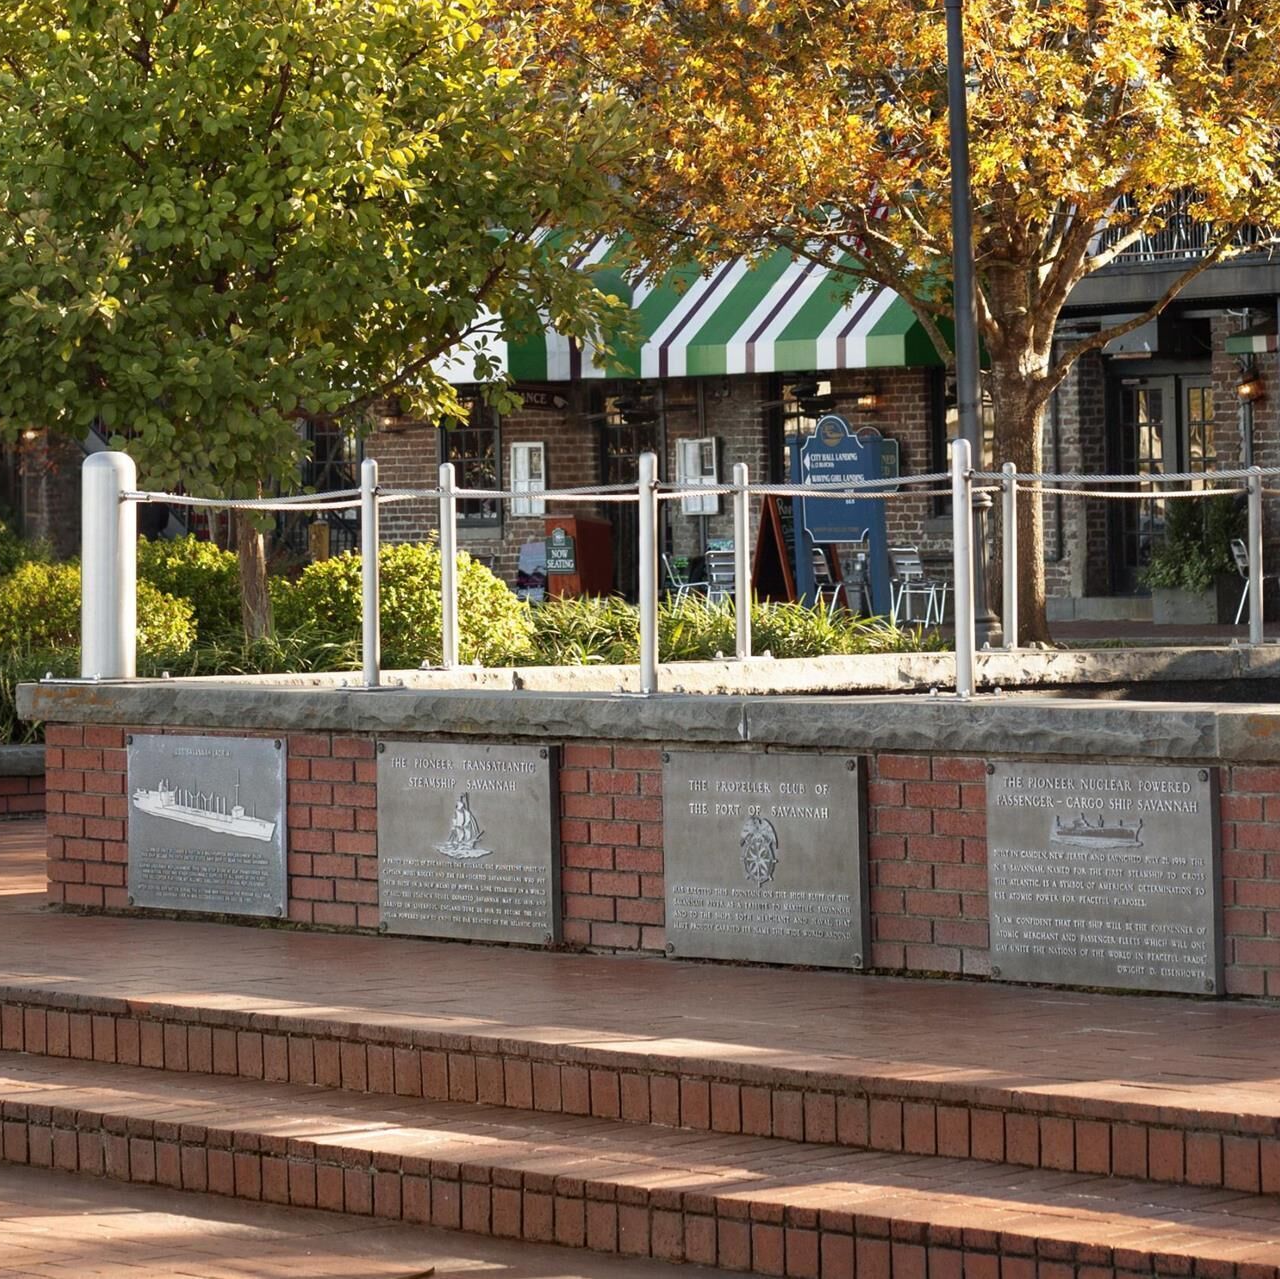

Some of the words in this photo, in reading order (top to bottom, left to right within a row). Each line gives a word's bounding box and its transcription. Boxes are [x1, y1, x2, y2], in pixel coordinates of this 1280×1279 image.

[810, 453, 821, 461] CITY
[822, 453, 835, 461] HALL
[836, 452, 858, 461] LANDING
[843, 474, 864, 482] LANDING
[552, 550, 568, 558] NOW
[547, 559, 574, 568] SEATING
[391, 758, 406, 768] THE
[414, 758, 452, 770] PIONEER
[462, 760, 534, 772] TRANSATLANTIC
[408, 777, 455, 789] STEAMSHIP
[466, 778, 516, 791] SAVANNAH
[688, 779, 706, 791] THE
[715, 780, 770, 793] PROPELLER
[779, 782, 805, 794] CLUB
[814, 783, 828, 795] OF
[1003, 776, 1022, 788] THE
[1027, 777, 1074, 789] PIONEER
[1080, 778, 1131, 791] NUCLEAR
[1138, 780, 1190, 793] POWERED
[688, 802, 707, 813] THE
[715, 804, 740, 815] PORT
[747, 805, 760, 816] OF
[771, 806, 829, 818] SAVANNAH
[996, 794, 1053, 807] PASSENGER
[1066, 797, 1103, 809] CARGO
[1108, 798, 1132, 810] SHIP
[1137, 799, 1198, 812] SAVANNAH
[1049, 851, 1064, 859] NEW
[1090, 853, 1104, 861] AND
[1107, 853, 1141, 862] LAUNCHED
[1046, 865, 1070, 874] NAMED
[1073, 866, 1086, 875] FOR
[1089, 867, 1102, 875] THE
[1128, 868, 1163, 878] STEAMSHIP
[1167, 870, 1176, 879] TO
[994, 877, 1006, 885] THE
[1042, 879, 1049, 887] IS
[1052, 880, 1057, 888] A
[1059, 880, 1084, 889] SYMBOL
[1086, 881, 1095, 890] OF
[1099, 882, 1133, 892] AMERICAN
[1138, 884, 1191, 894] DETERMINATION
[1195, 886, 1204, 895] TO
[1009, 892, 1032, 901] ATOMIC
[1036, 893, 1058, 902] POWER
[1062, 894, 1075, 903] FOR
[1016, 915, 1052, 926] CONFIDENT
[1054, 918, 1071, 927] THAT
[1073, 919, 1085, 928] THE
[1088, 920, 1103, 929] SHIP
[1196, 926, 1206, 935] OF
[996, 929, 1018, 938] ATOMIC
[1023, 930, 1059, 941] MERCHANT
[1062, 933, 1076, 942] AND
[1080, 934, 1115, 944] PASSENGER
[1144, 938, 1167, 948] WHICH
[1170, 939, 1187, 949] WILL
[1190, 940, 1205, 950] ONE
[1033, 945, 1045, 954] THE
[1048, 946, 1076, 956] NATIONS
[1080, 948, 1088, 956] OF
[1092, 948, 1104, 957] THE
[1107, 949, 1131, 959] WORLD
[1135, 951, 1143, 960] IN
[1117, 964, 1145, 974] DWIGHT
